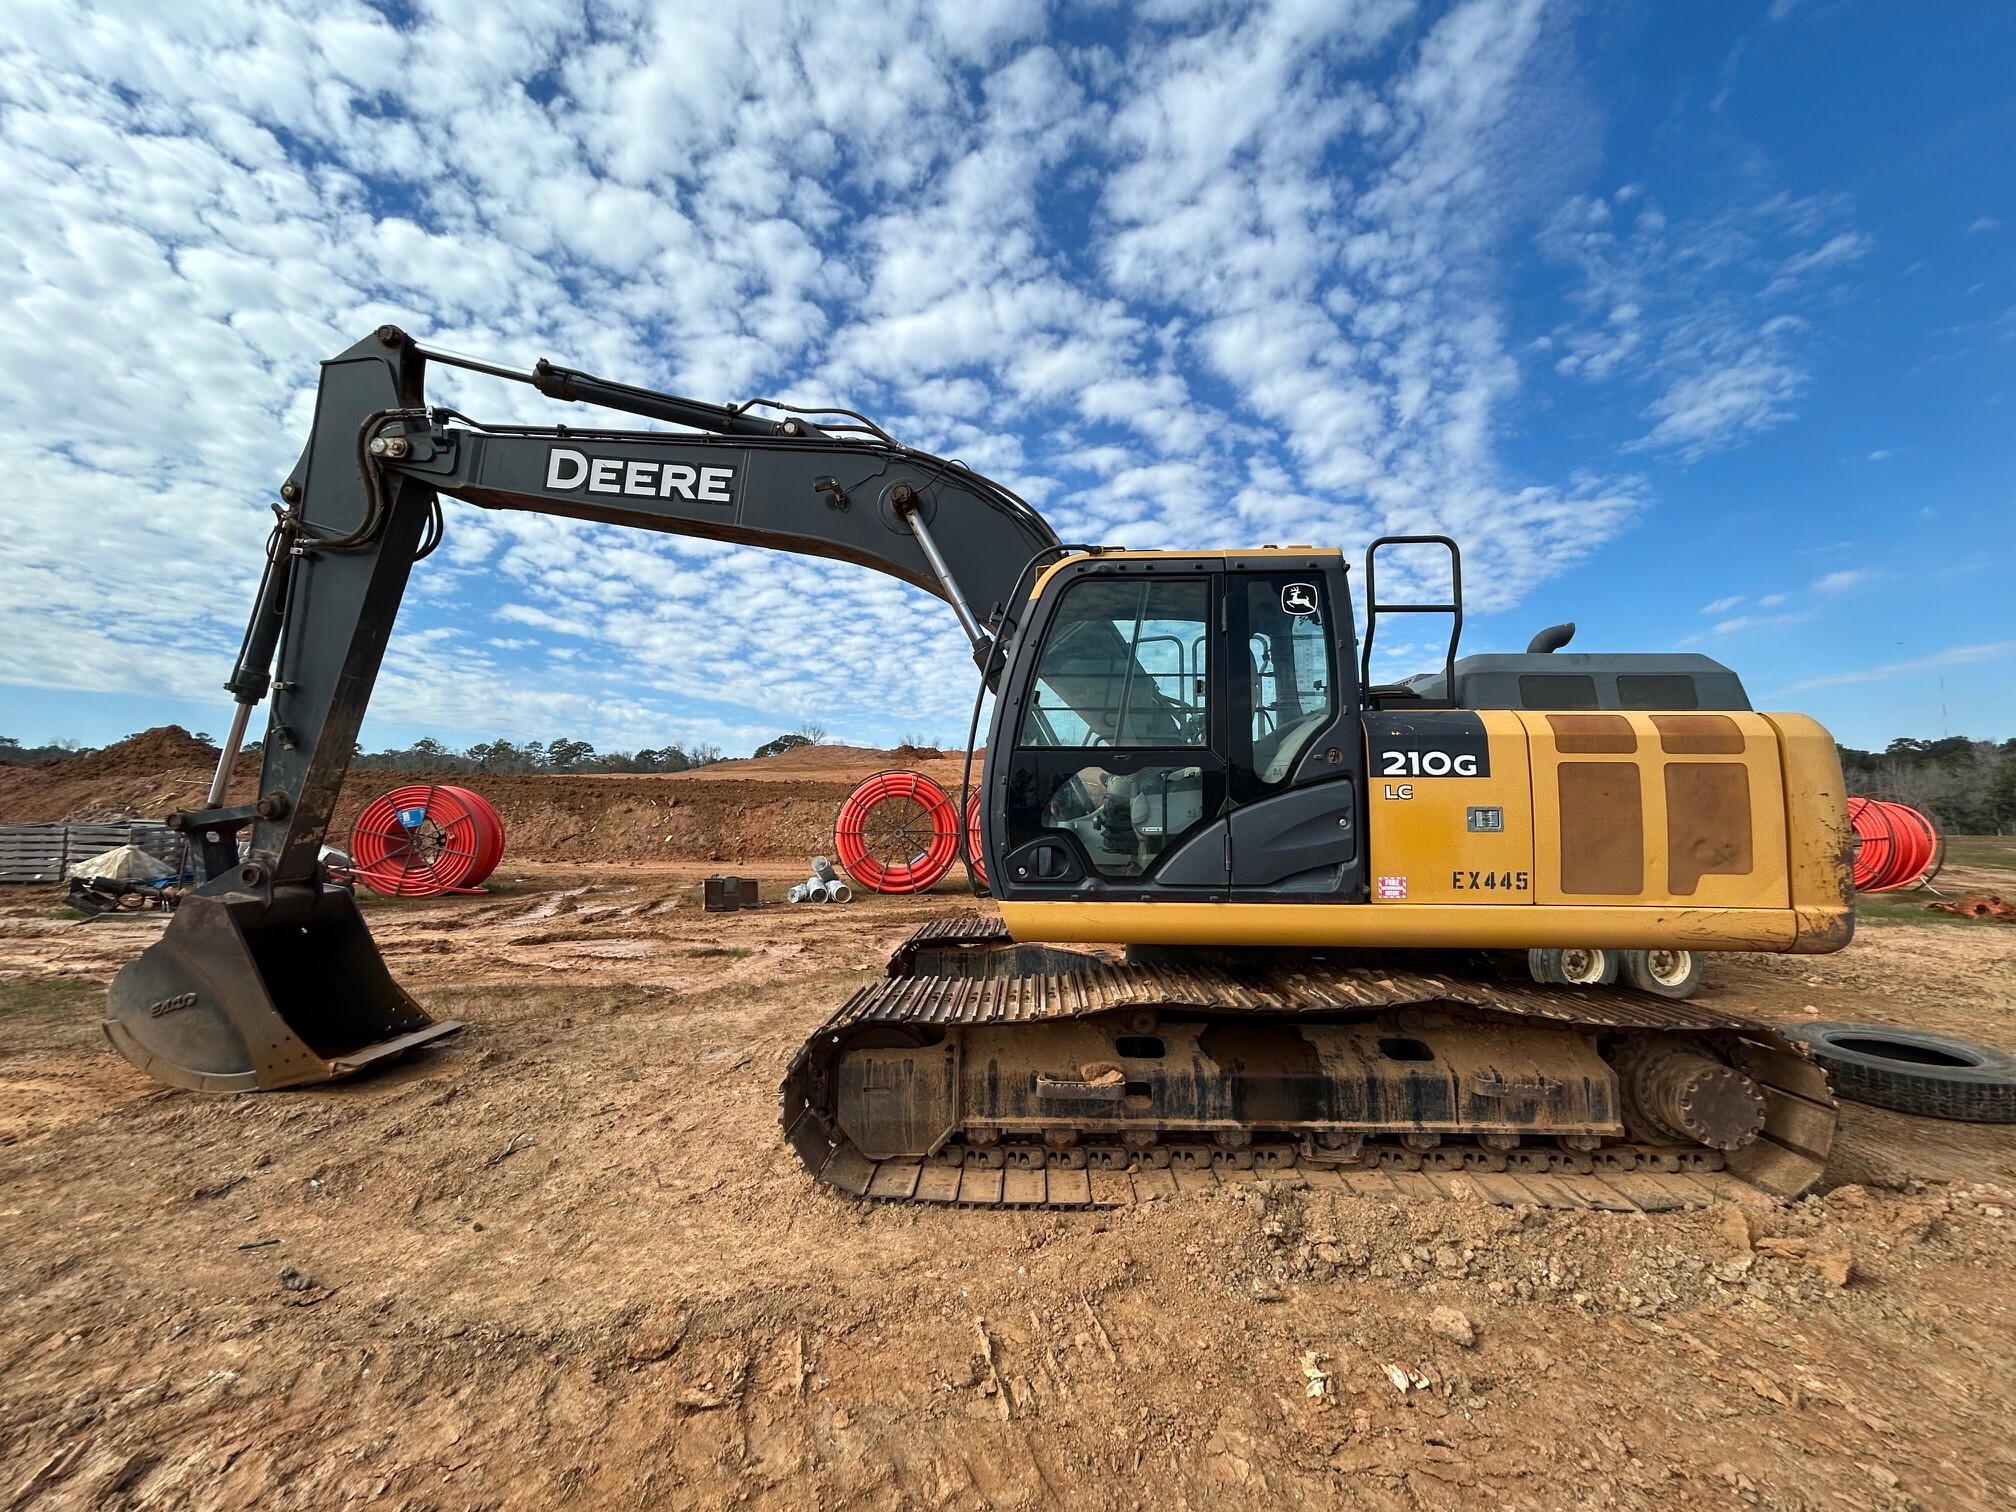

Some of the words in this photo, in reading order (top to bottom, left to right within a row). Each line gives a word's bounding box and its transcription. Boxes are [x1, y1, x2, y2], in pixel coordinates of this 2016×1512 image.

[546, 448, 734, 502] DEERE
[1382, 751, 1477, 776] 210G
[1385, 784, 1413, 800] LC
[1452, 871, 1528, 890] EX445
